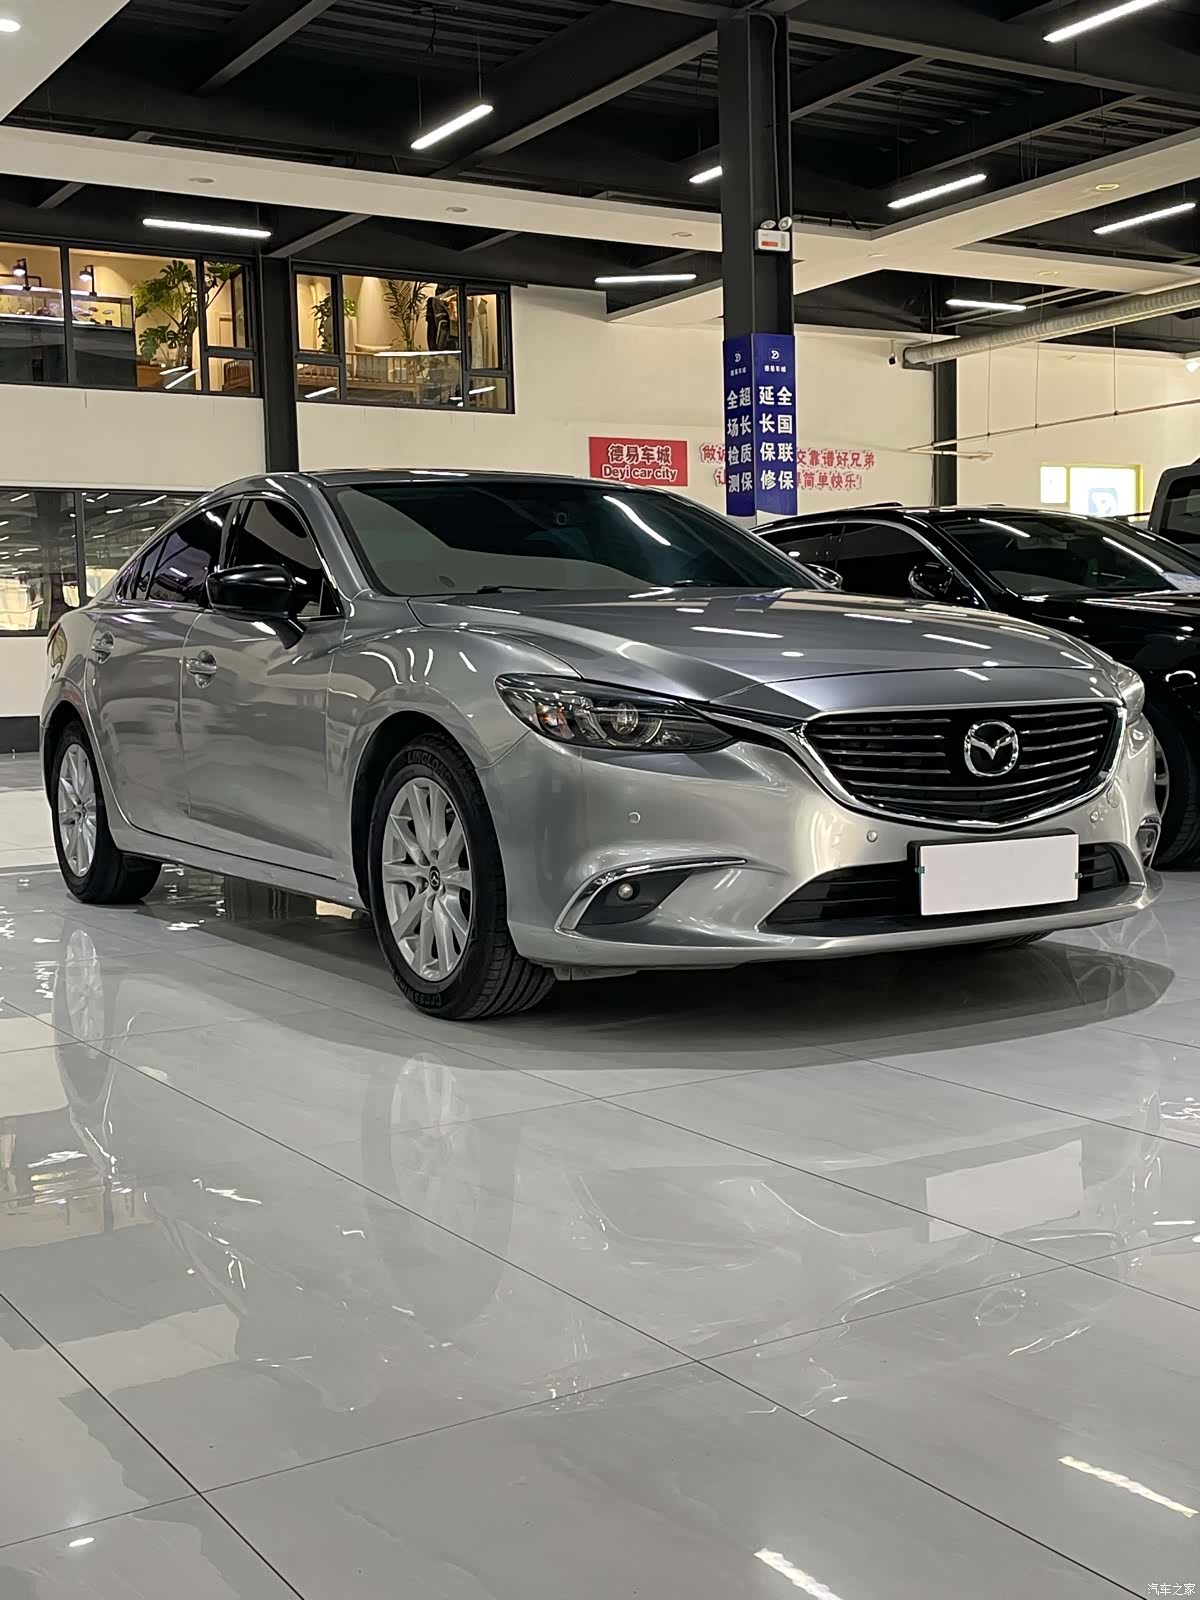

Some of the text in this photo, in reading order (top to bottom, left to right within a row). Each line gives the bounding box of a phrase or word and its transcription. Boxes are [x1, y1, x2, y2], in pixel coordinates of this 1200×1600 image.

[602, 464, 678, 482] Deyi car city
[608, 444, 672, 466] 德易车城
[726, 389, 740, 493] 全场检测
[739, 386, 753, 492] 超长质保
[758, 385, 777, 490] 延长保修
[776, 385, 794, 490] 全国联保
